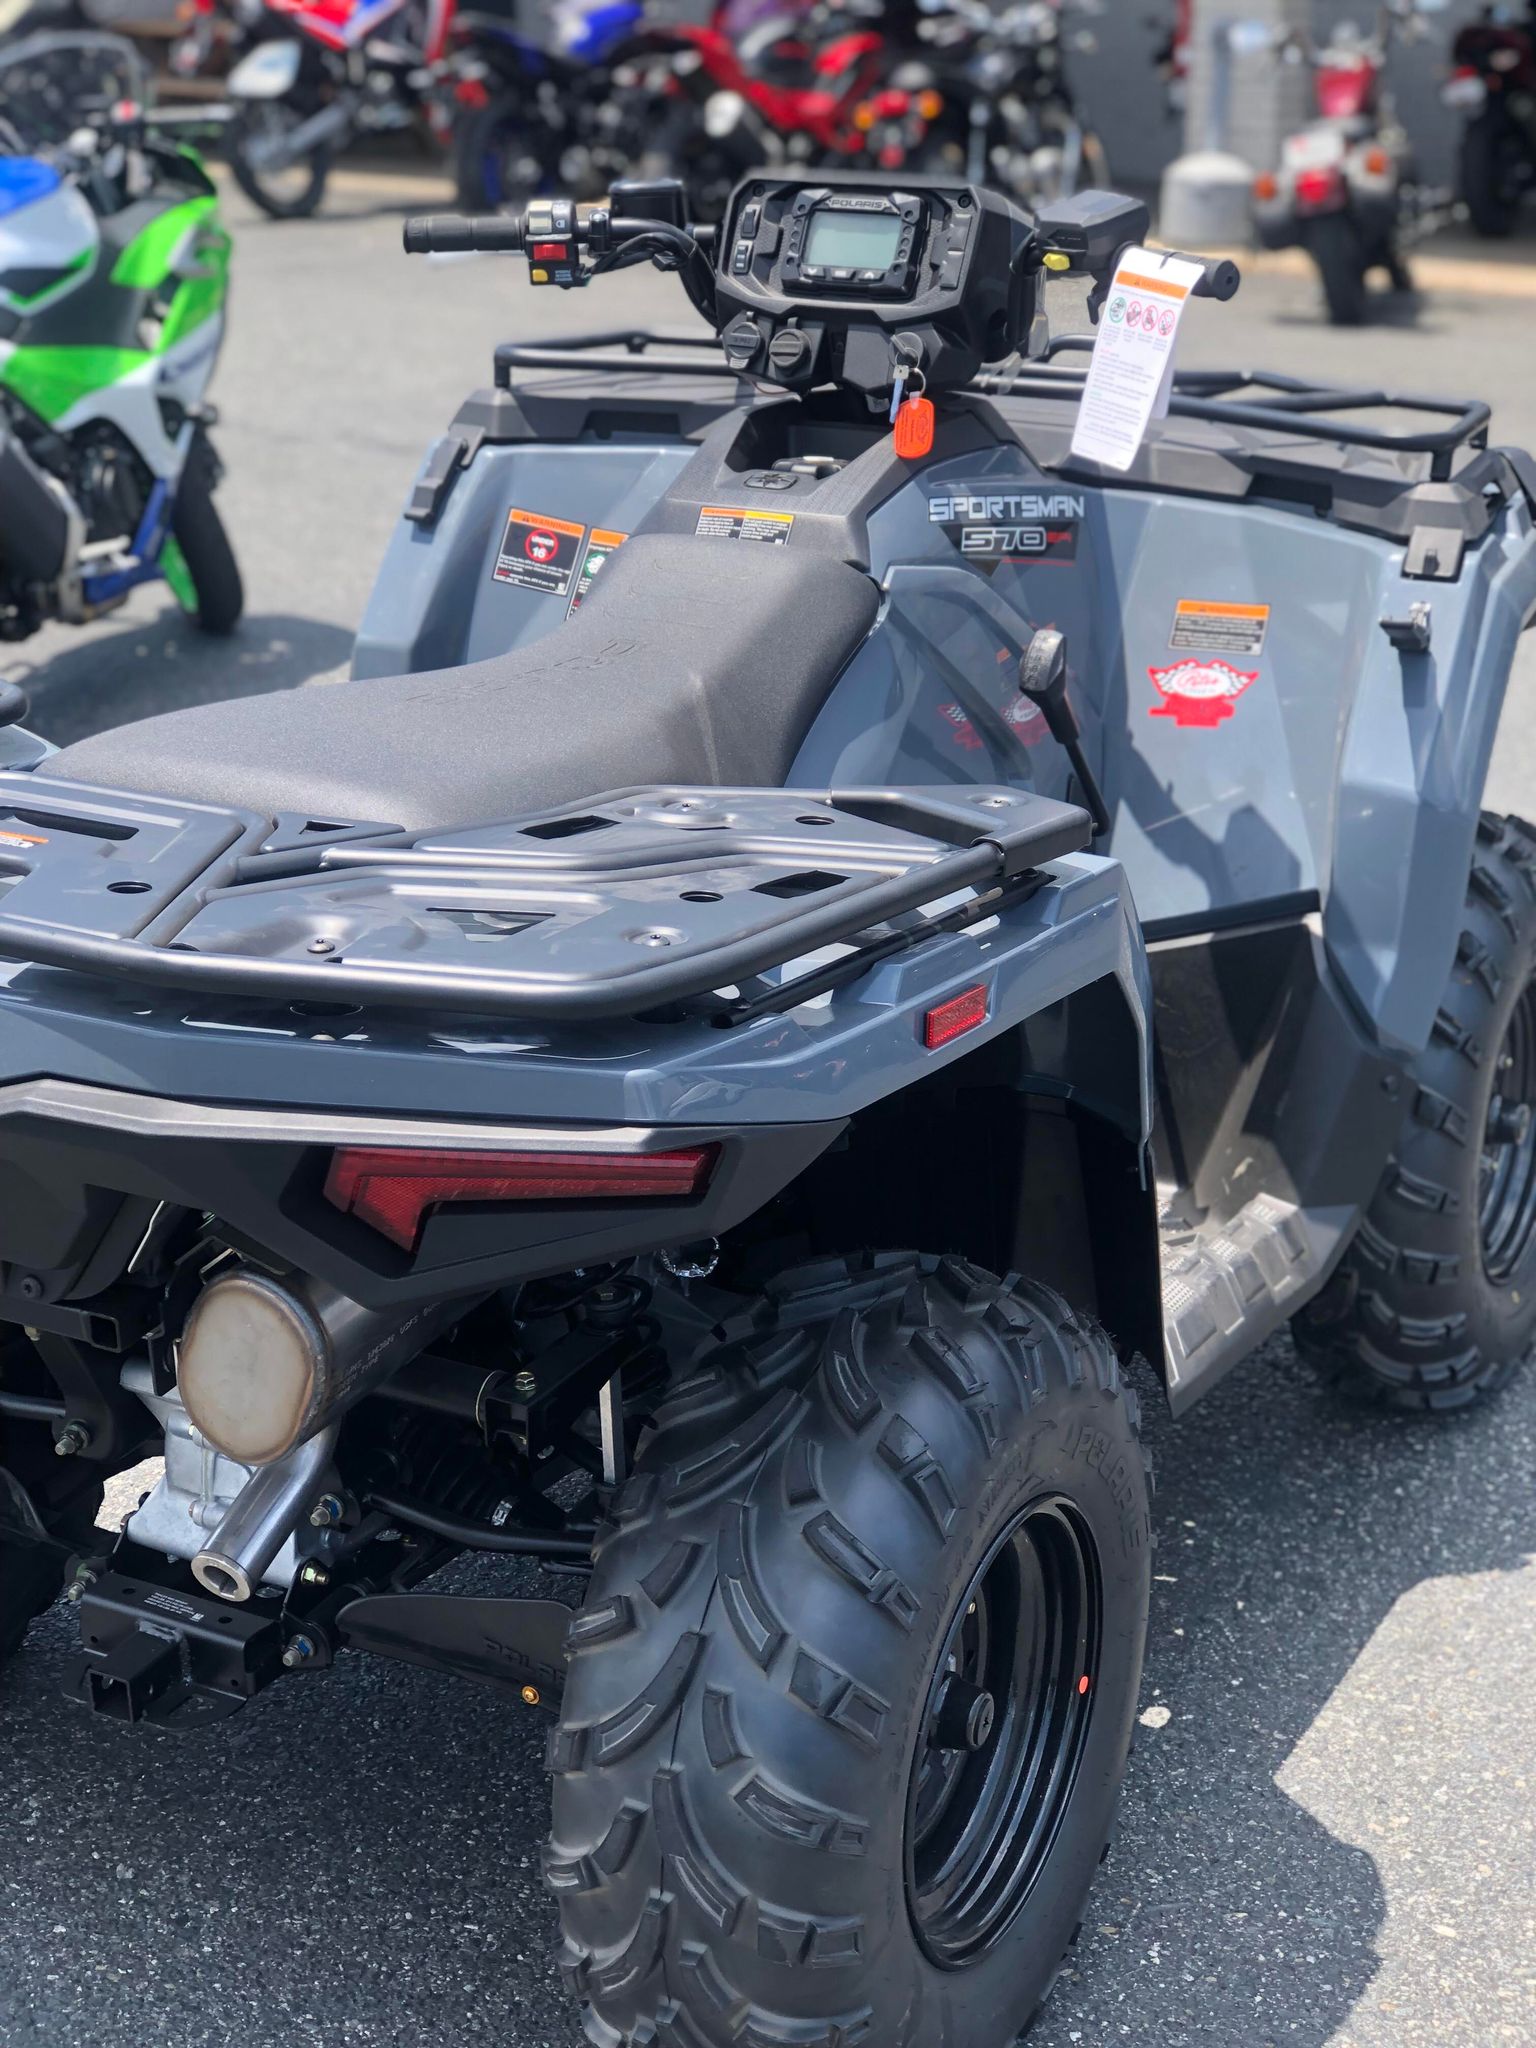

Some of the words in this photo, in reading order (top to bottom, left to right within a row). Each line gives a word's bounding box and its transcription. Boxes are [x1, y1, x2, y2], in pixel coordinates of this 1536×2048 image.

[831, 199, 883, 208] POLARIS
[929, 494, 1085, 522] SPORTSMAN
[961, 526, 1047, 552] 570
[532, 546, 547, 559] 16
